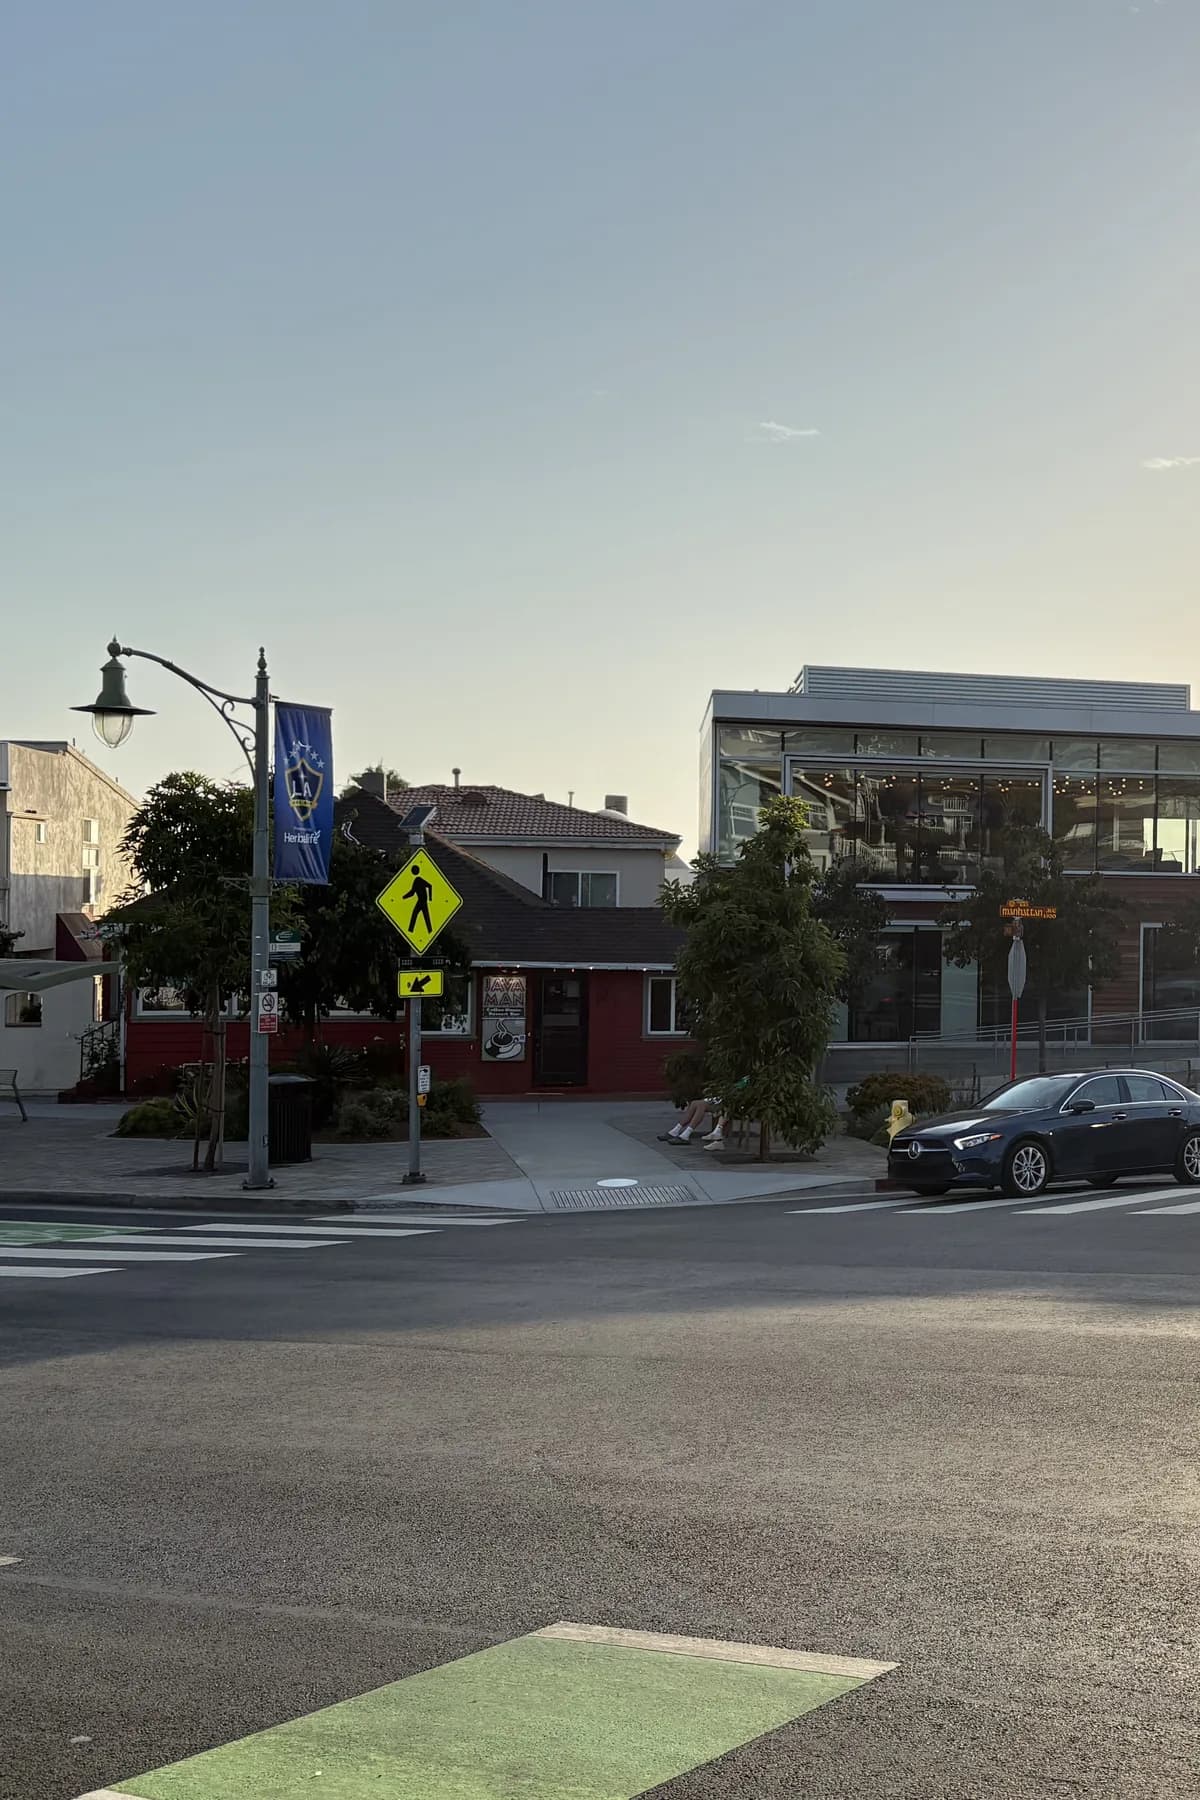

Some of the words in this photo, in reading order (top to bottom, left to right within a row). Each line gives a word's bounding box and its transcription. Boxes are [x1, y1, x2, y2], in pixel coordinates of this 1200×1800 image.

[290, 780, 312, 798] LA
[284, 831, 320, 844] Herbalife
[484, 978, 525, 992] JAVA
[484, 992, 525, 1006] MAN
